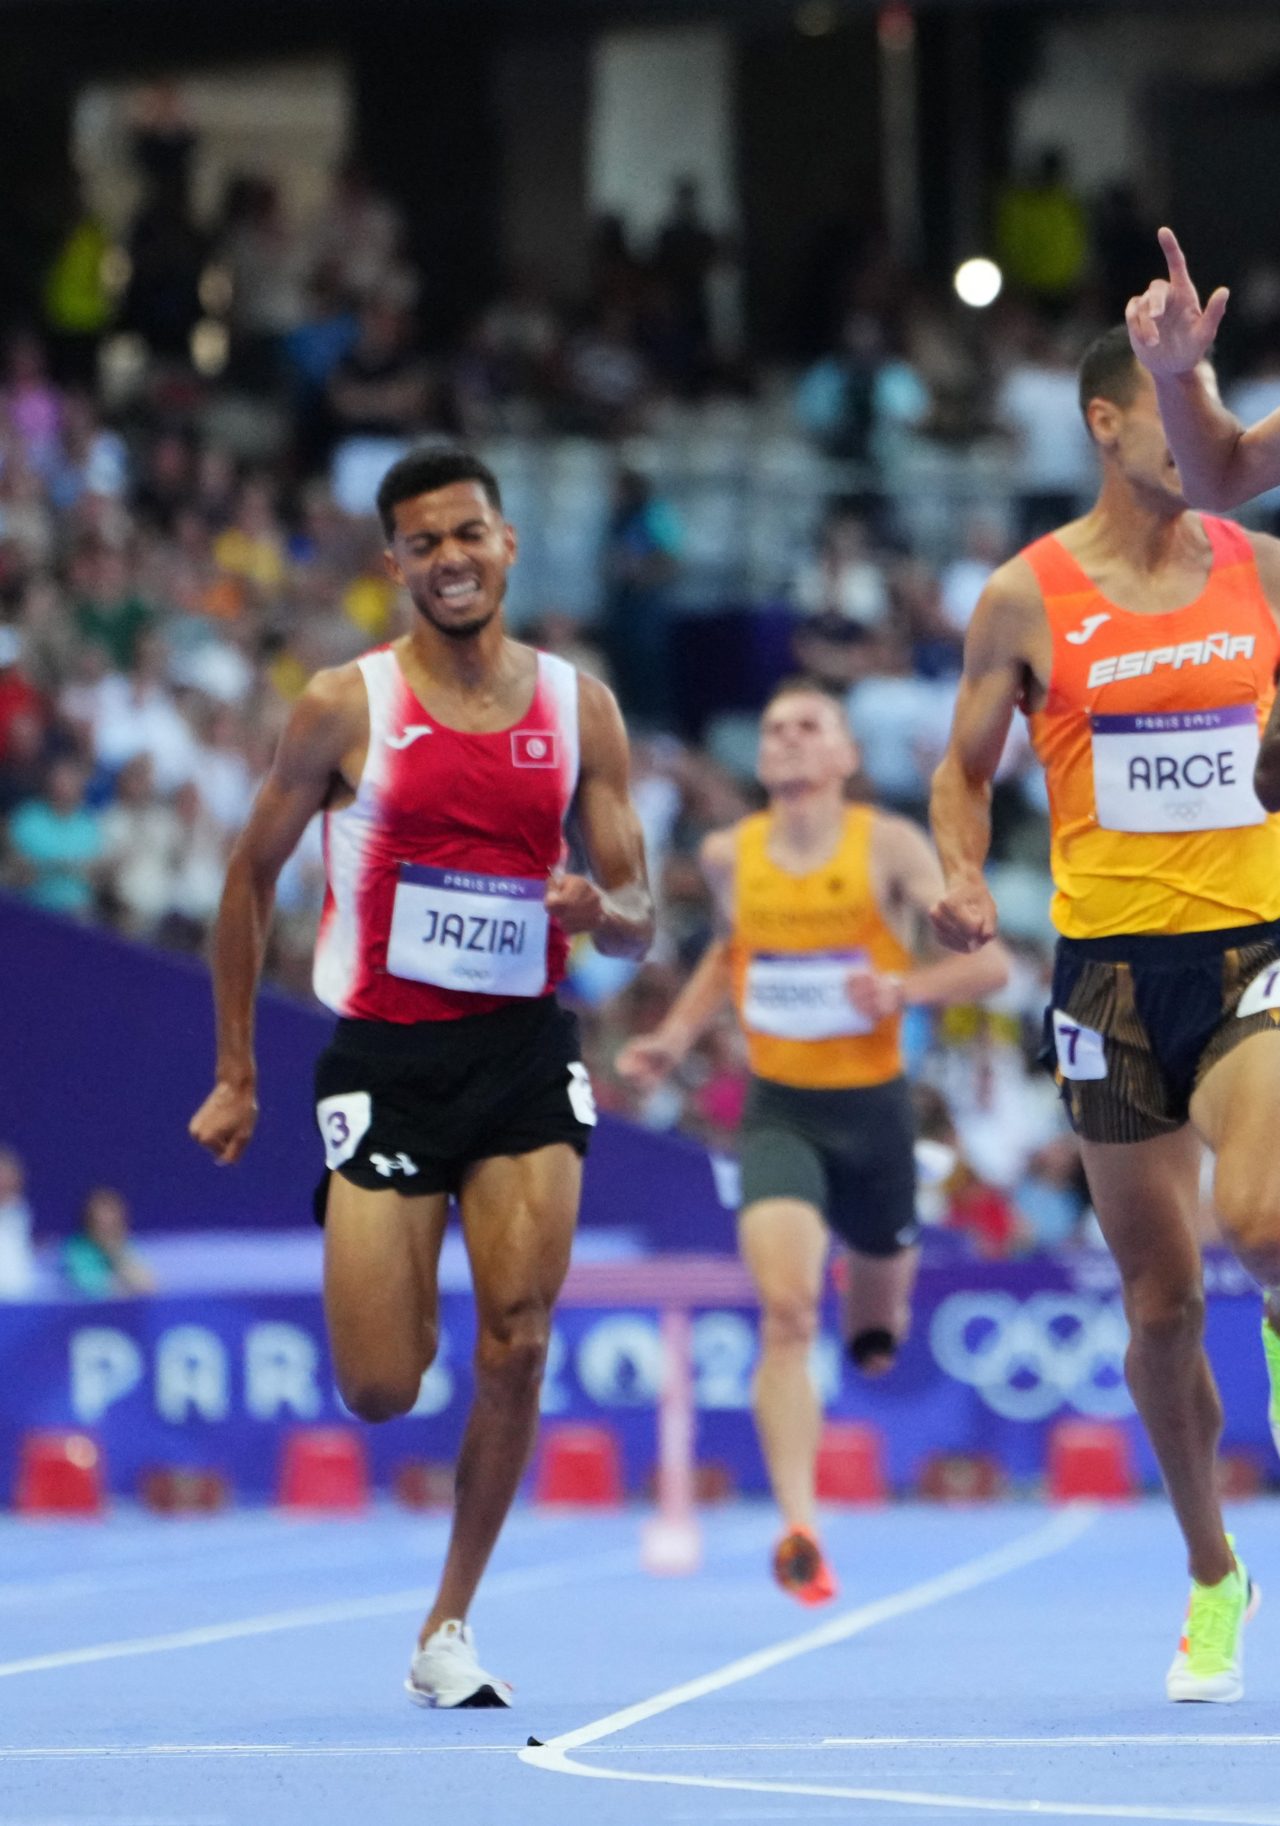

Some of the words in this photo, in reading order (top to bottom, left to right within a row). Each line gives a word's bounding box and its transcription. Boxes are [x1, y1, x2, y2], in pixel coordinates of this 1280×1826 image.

[1087, 631, 1256, 689] ESPAÑA
[1135, 716, 1180, 729] PARIS
[1128, 751, 1236, 791] ARCE
[444, 874, 484, 891] PARIS
[421, 910, 527, 956] JAZIRI
[1059, 1026, 1081, 1065] 7
[326, 1109, 352, 1148] 3
[69, 1323, 453, 1422] PAR
